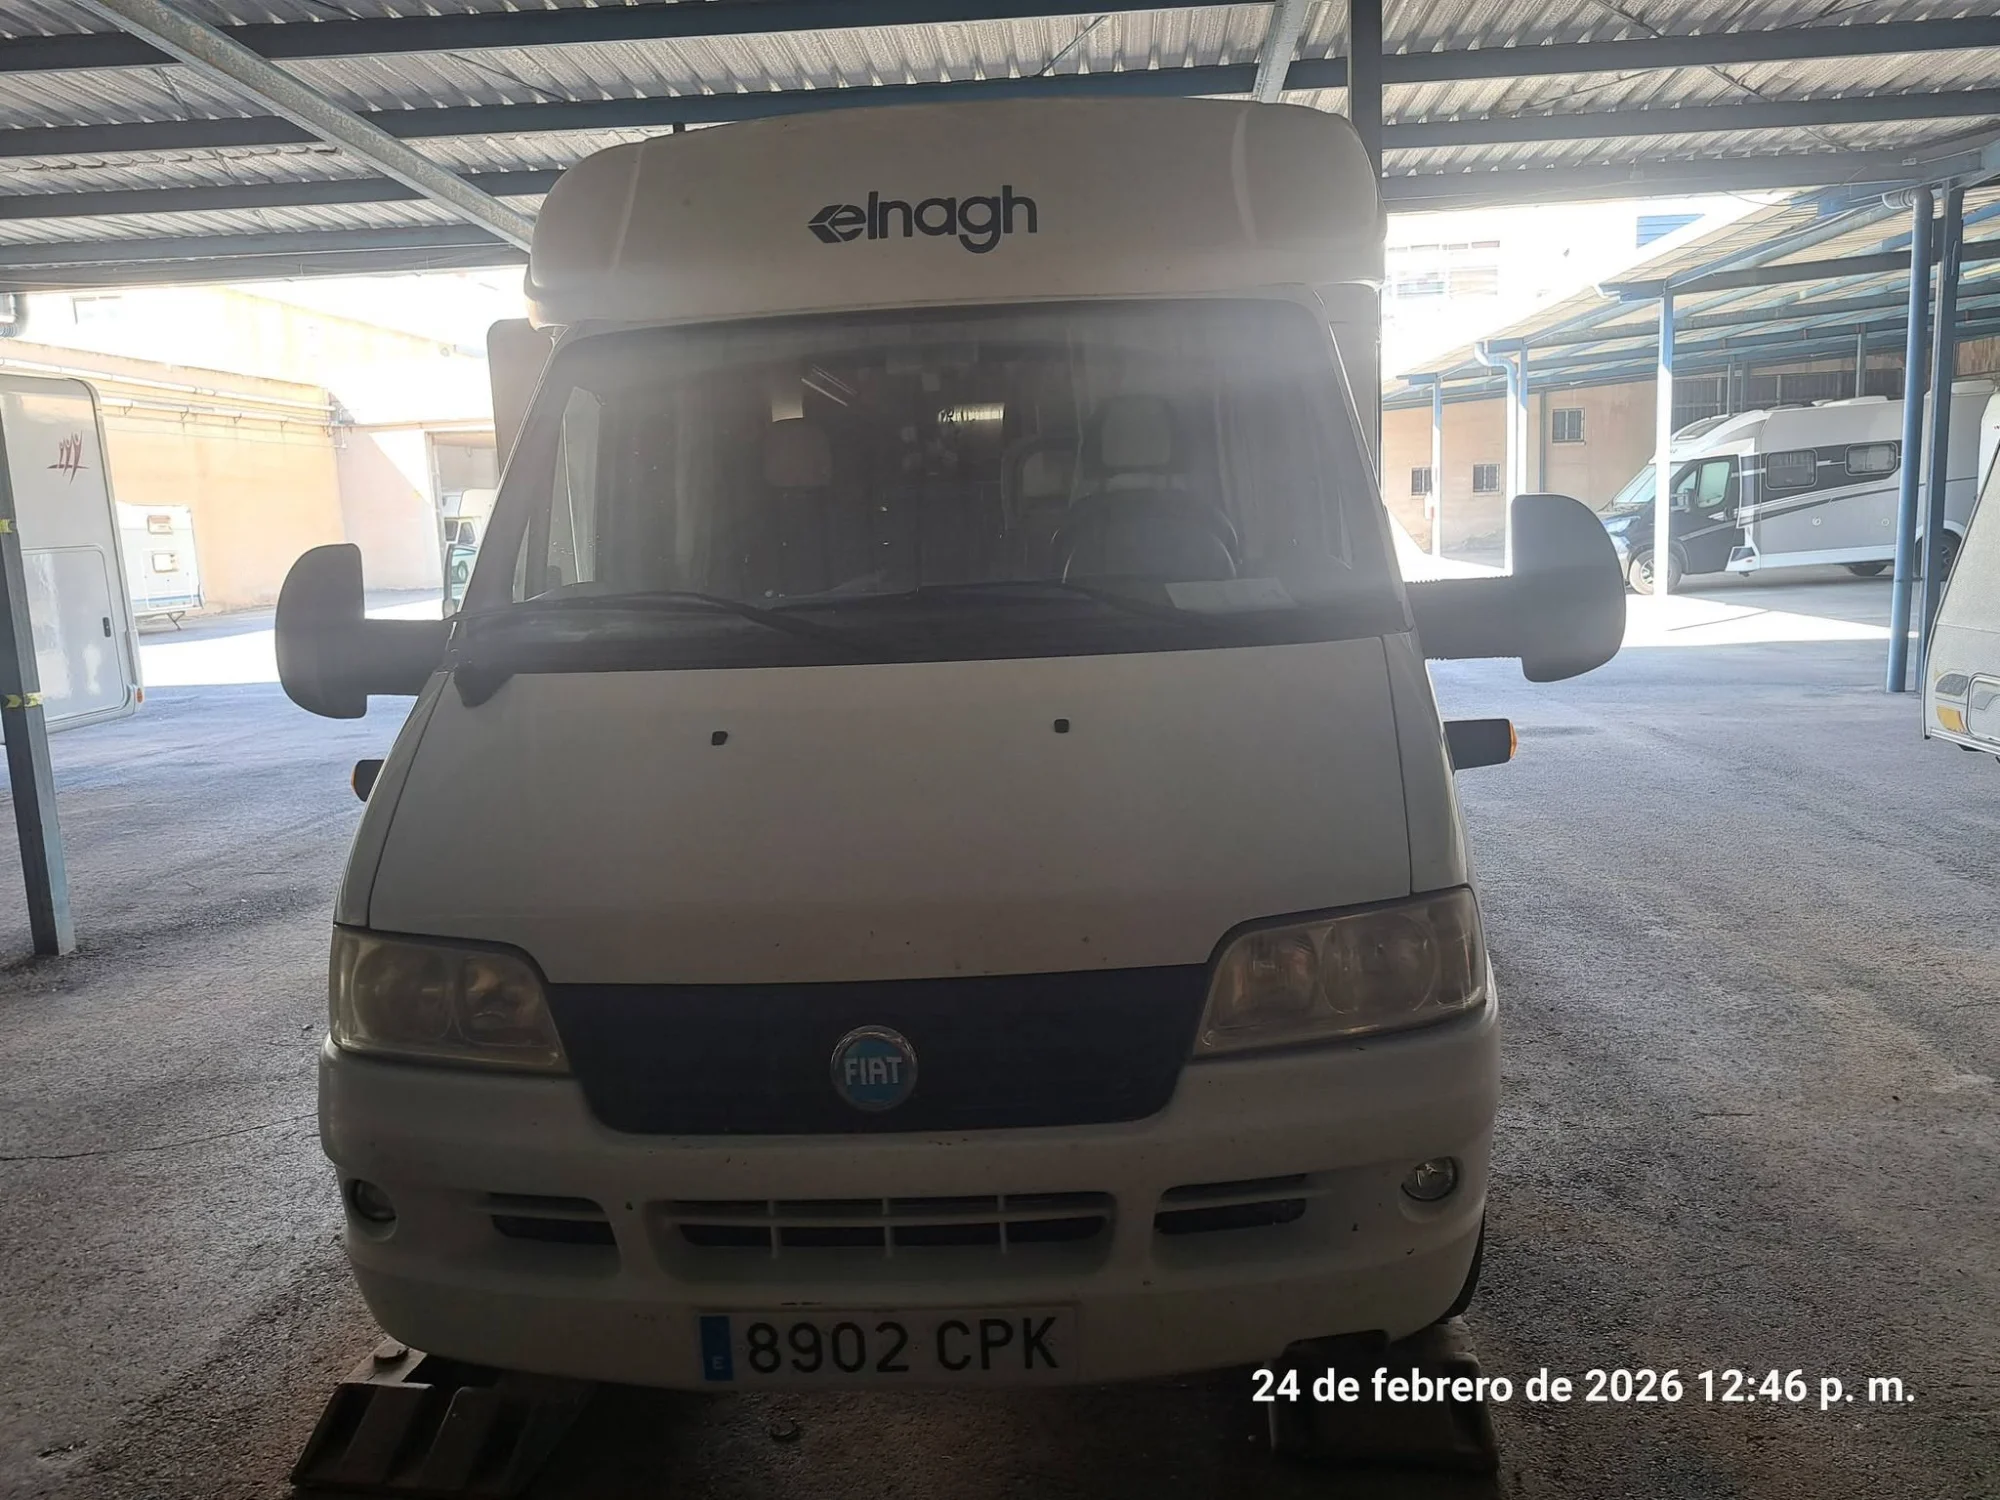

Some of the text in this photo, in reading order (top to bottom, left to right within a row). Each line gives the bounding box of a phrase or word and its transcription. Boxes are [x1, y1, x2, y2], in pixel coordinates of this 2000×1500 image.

[808, 184, 1038, 254] elnagh
[844, 1056, 902, 1085] FIAT
[712, 1355, 724, 1370] E
[746, 1316, 1059, 1374] 8902 CPK
